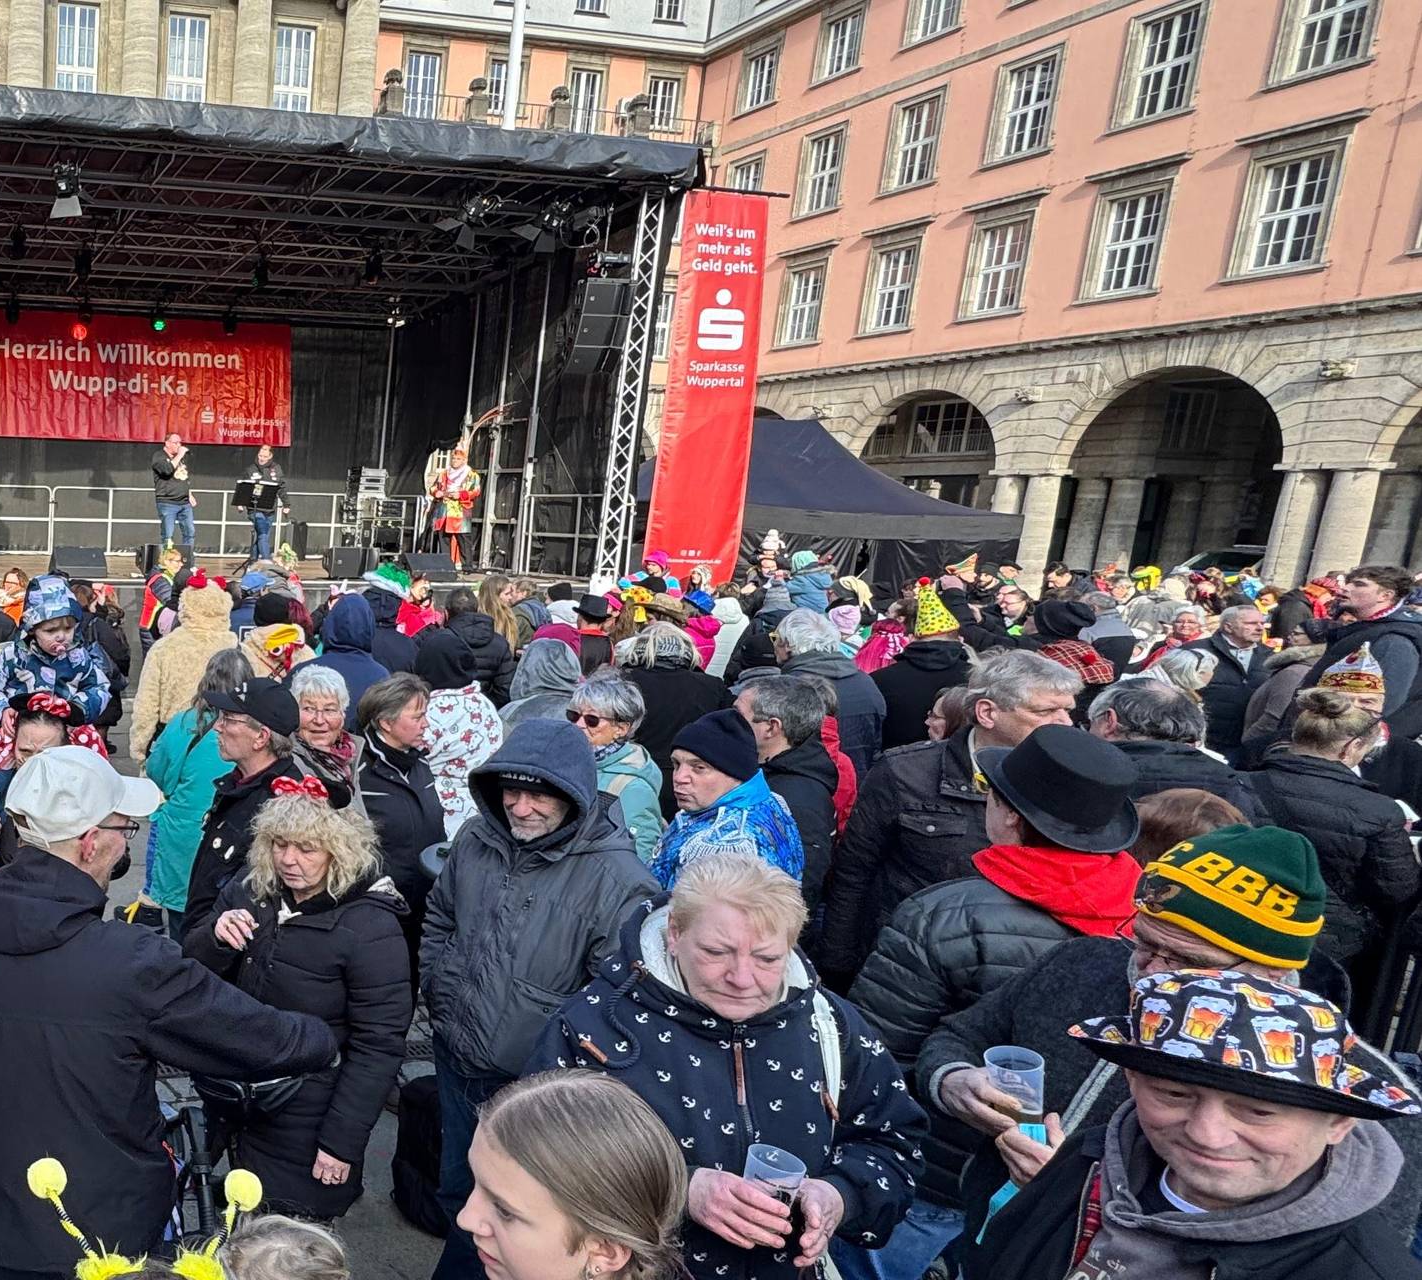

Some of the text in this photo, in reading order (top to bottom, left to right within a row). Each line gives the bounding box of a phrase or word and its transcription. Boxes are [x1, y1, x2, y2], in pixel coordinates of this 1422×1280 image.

[694, 223, 756, 239] Weil's um
[697, 242, 752, 256] mehr als
[691, 259, 758, 275] Geld geht.
[97, 343, 241, 370] Willkommen
[689, 360, 744, 373] Sparkasse
[48, 369, 188, 398] Wupp-di-Ka
[686, 376, 744, 388] Wuppertal
[218, 414, 284, 427] Stadtsparkasse
[218, 427, 264, 438] Wuppertal
